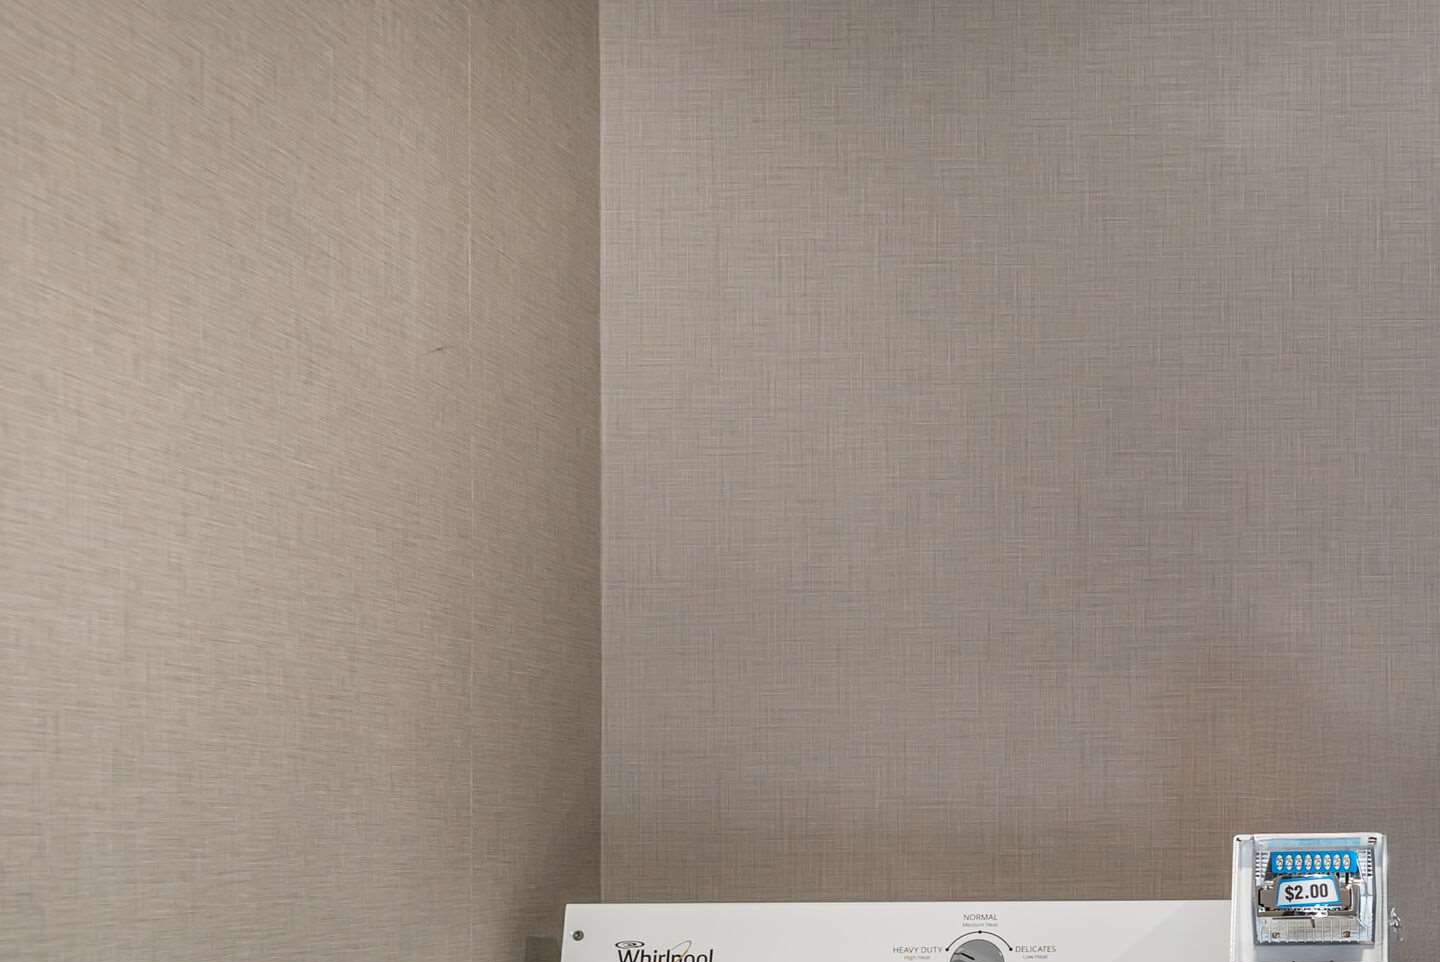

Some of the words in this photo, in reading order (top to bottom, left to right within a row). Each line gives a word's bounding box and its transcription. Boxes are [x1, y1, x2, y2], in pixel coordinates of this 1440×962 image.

[1284, 883, 1329, 902] $2.00
[892, 946, 918, 954] HEAVY
[919, 946, 943, 954] DUTY
